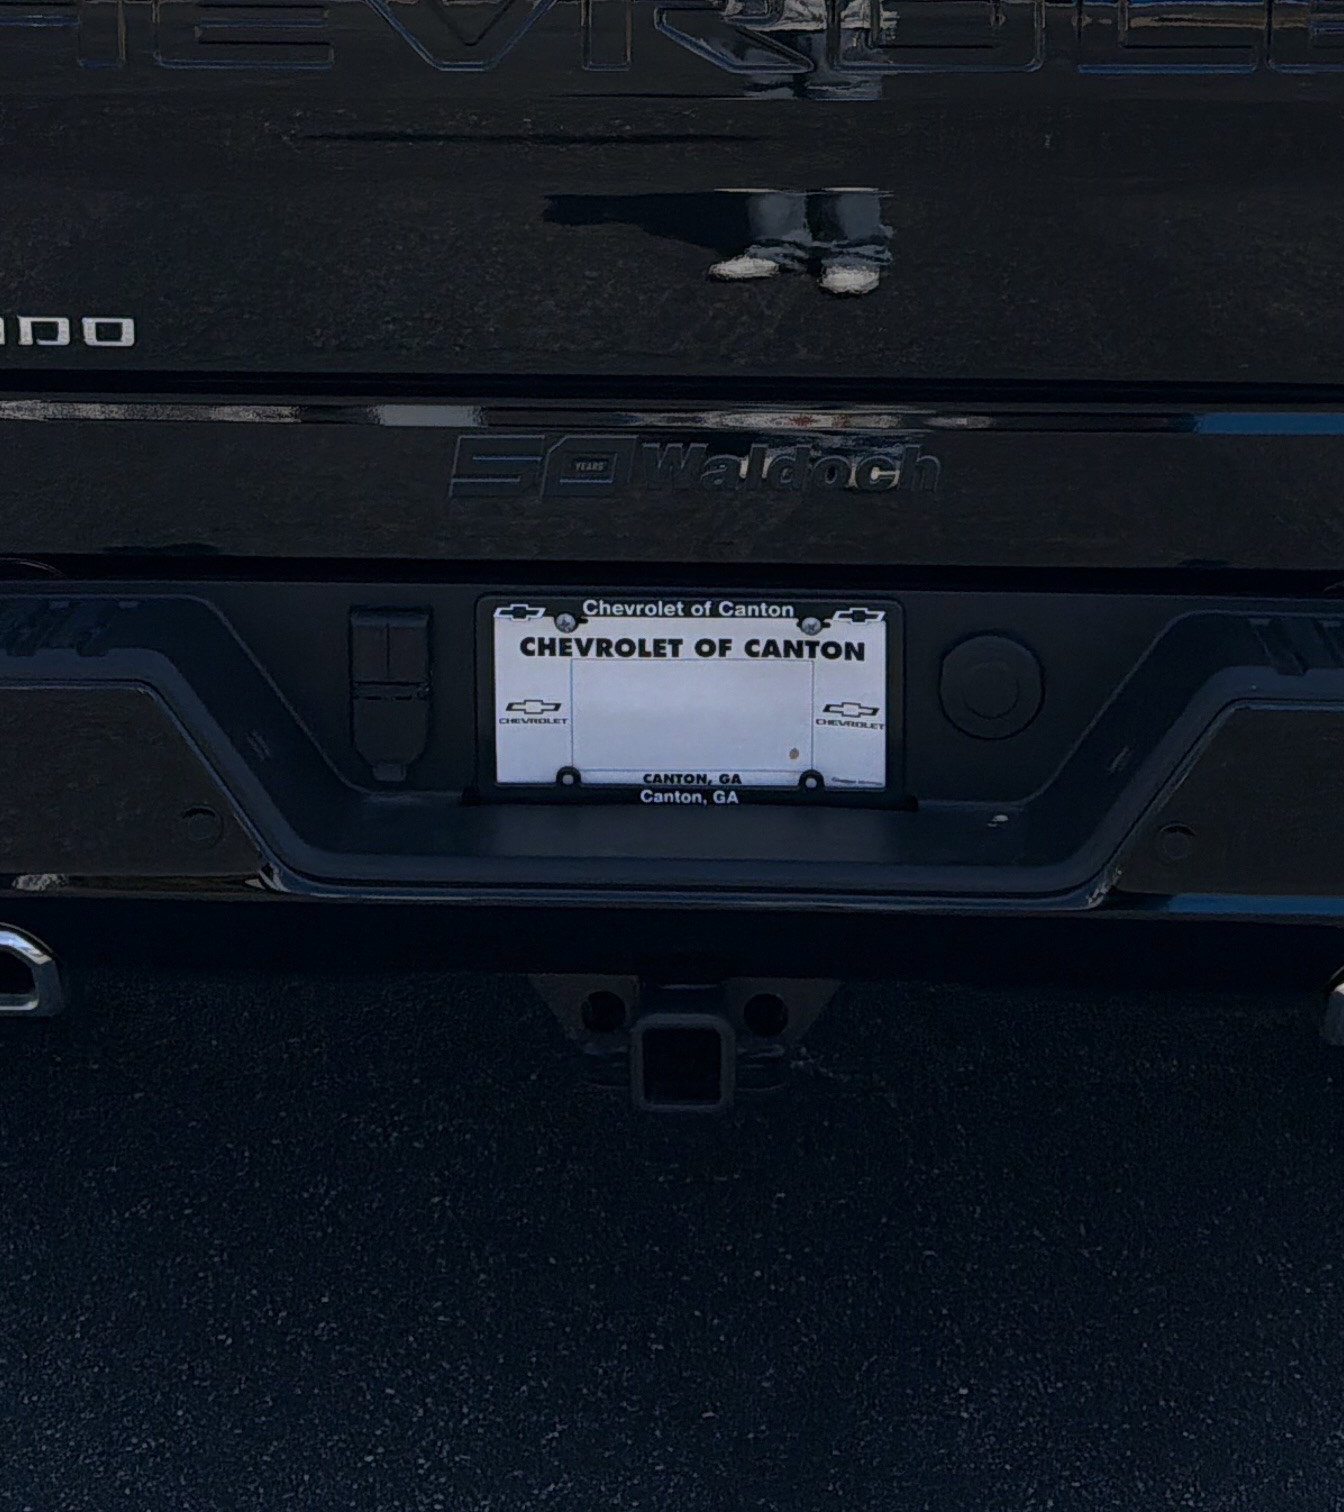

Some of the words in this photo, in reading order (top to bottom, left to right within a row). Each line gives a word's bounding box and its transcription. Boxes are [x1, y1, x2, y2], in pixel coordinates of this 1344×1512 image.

[575, 459, 604, 473] YEARS
[642, 441, 943, 492] Waldoch
[582, 599, 685, 618] Chevrolet
[691, 600, 714, 617] of
[717, 600, 795, 619] Canton
[519, 636, 684, 658] CHEVROLET
[694, 637, 733, 658] OF
[744, 638, 866, 661] CANTON
[498, 717, 569, 725] CHEVROLET
[815, 718, 885, 730] CHEVROLET
[642, 772, 713, 786] CANTON,
[719, 773, 742, 785] GA
[640, 789, 707, 806] Canton,
[712, 790, 739, 804] GA
